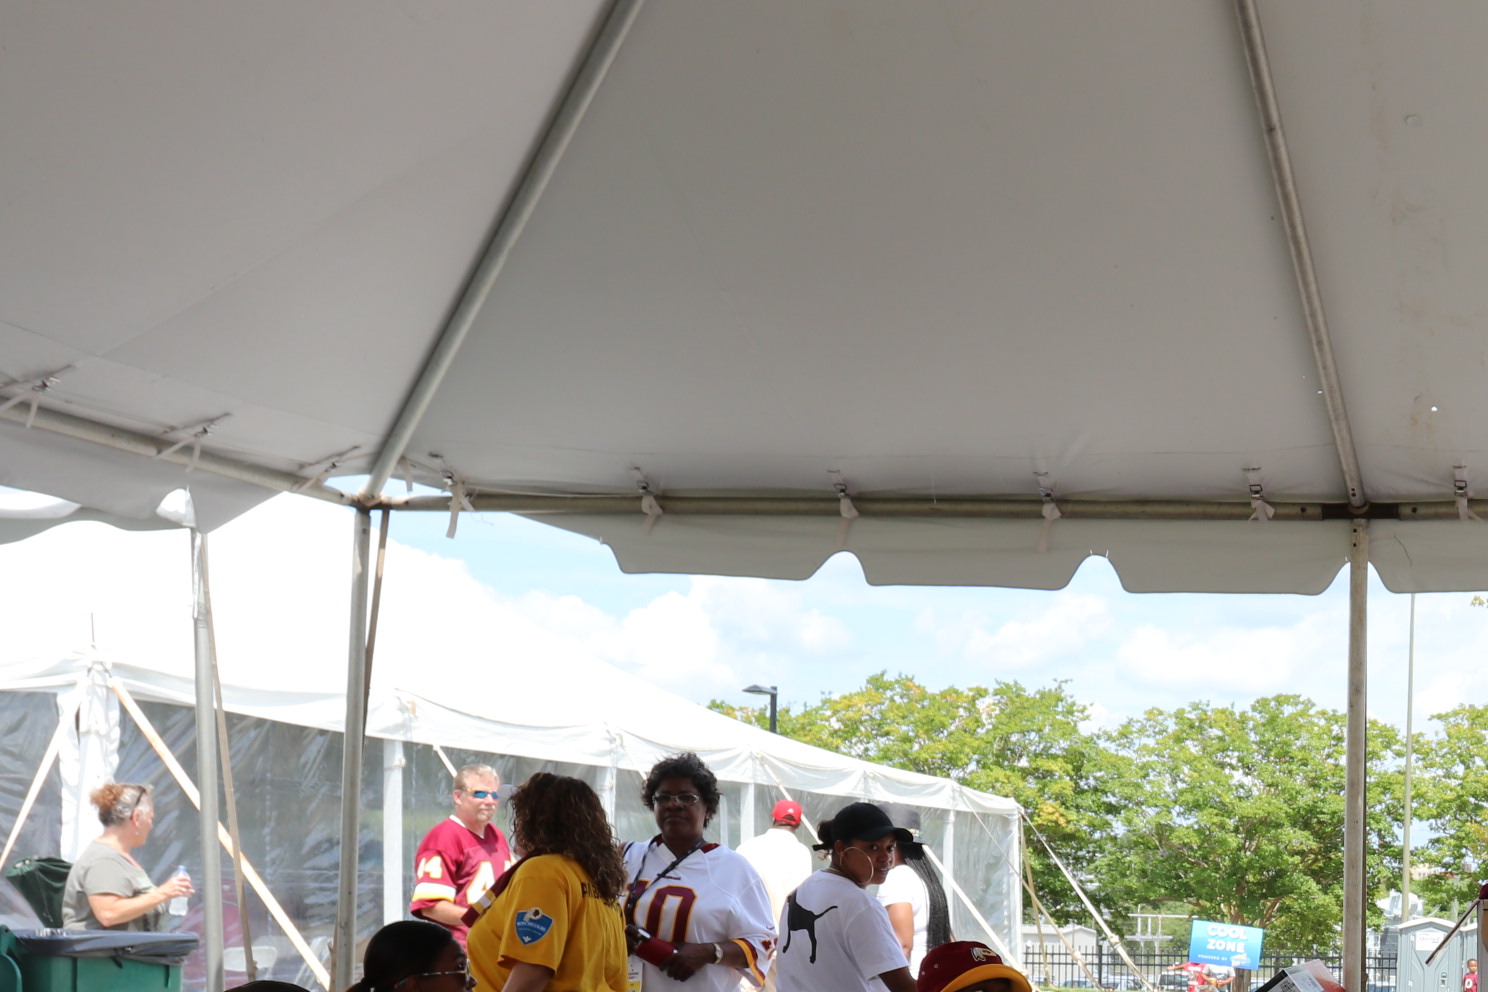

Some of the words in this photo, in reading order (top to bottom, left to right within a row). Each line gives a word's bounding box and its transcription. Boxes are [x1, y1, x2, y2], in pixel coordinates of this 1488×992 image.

[624, 880, 698, 943] 10
[1207, 924, 1248, 940] COOL
[1206, 938, 1245, 953] ZONE
